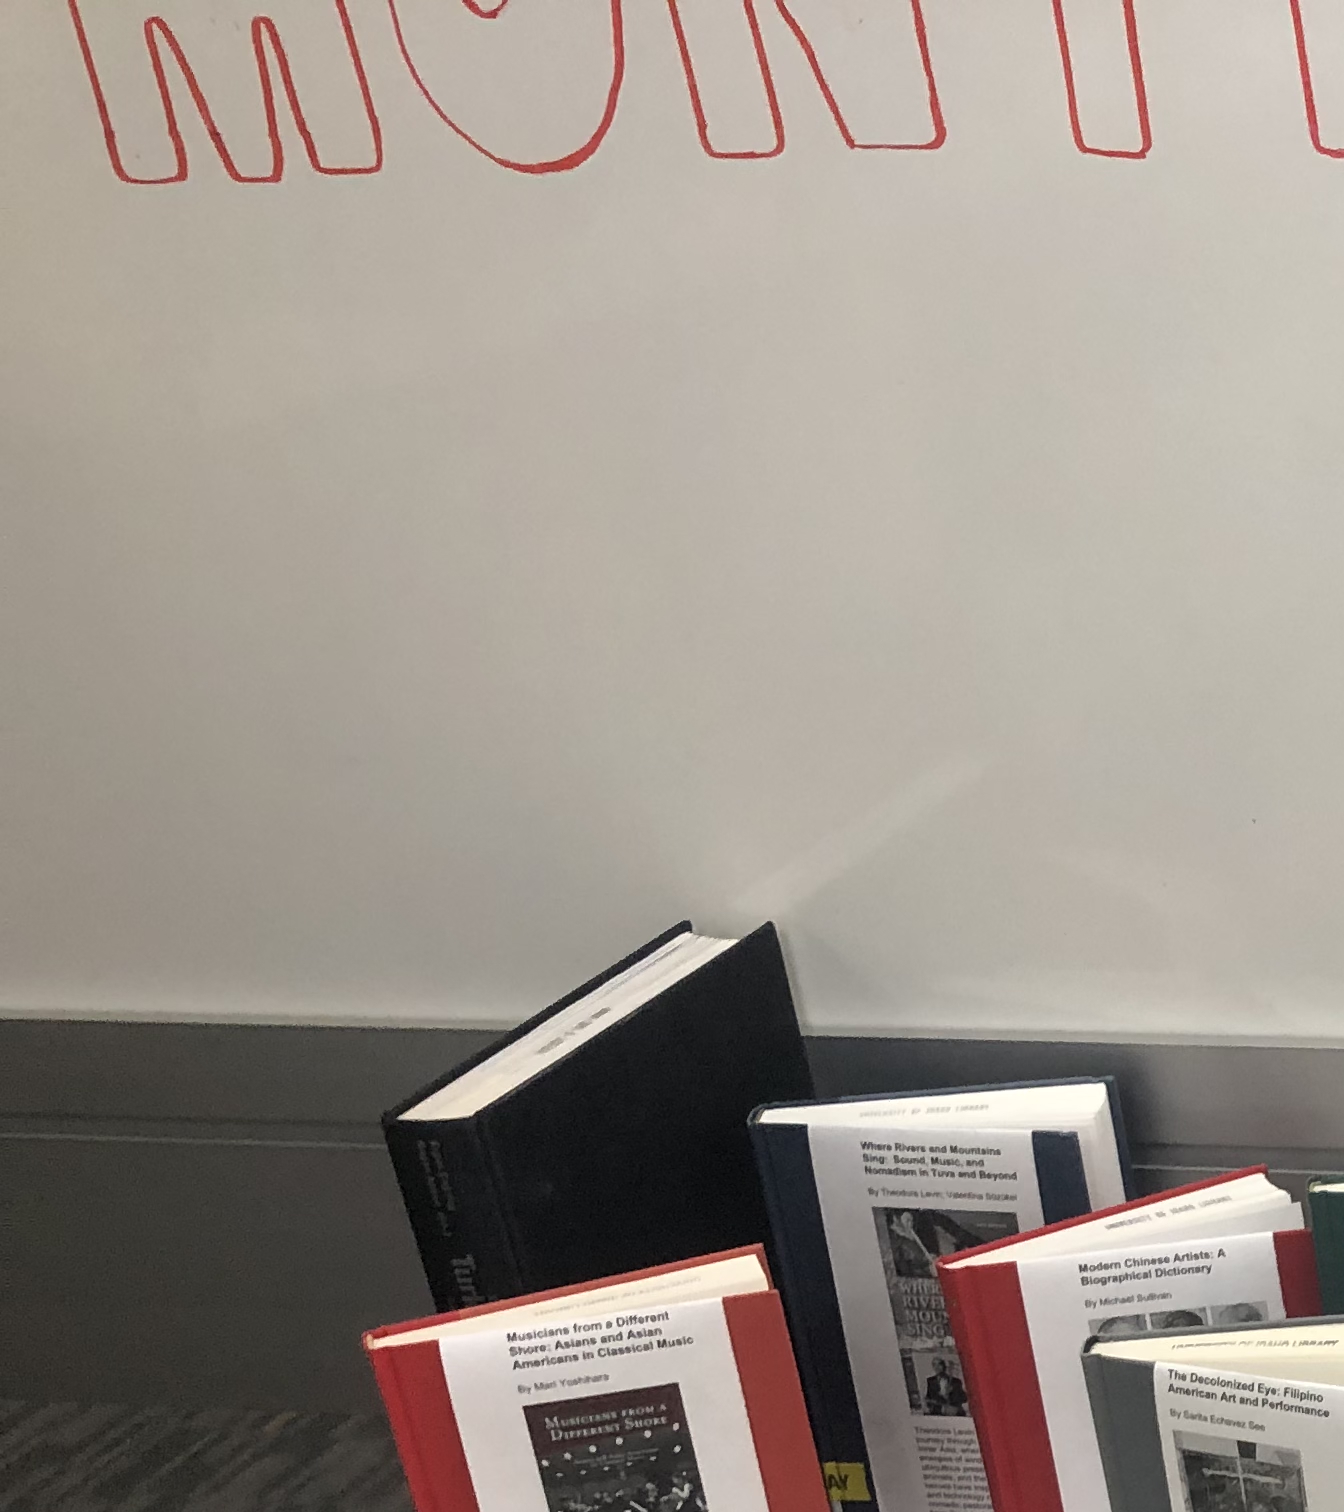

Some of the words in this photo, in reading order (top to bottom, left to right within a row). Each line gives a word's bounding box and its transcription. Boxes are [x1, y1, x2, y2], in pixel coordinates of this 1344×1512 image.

[860, 1141, 892, 1151] Where
[895, 1143, 926, 1152] Rivers
[929, 1144, 947, 1154] and
[950, 1144, 1002, 1156] Mountains
[893, 1154, 928, 1166] Sound,
[931, 1156, 963, 1167] Music,
[965, 1158, 985, 1167] and
[865, 1166, 917, 1177] Nomadism
[919, 1168, 929, 1177] in
[931, 1168, 956, 1178] Tuva
[958, 1170, 976, 1178] and
[979, 1170, 1018, 1181] Beyond
[1078, 1261, 1121, 1274] Modern
[1124, 1256, 1170, 1269] Chinese
[1173, 1251, 1214, 1264] Artists:
[1217, 1247, 1226, 1258] A
[1081, 1269, 1152, 1287] Biographical
[1155, 1264, 1213, 1278] Dictionary
[1085, 1299, 1097, 1310] By
[1100, 1295, 1134, 1307] Michael
[1137, 1291, 1173, 1303] Sullivan
[506, 1326, 570, 1343] Musicians
[572, 1321, 603, 1334] from
[605, 1320, 613, 1330] a
[615, 1311, 670, 1328] Different
[509, 1343, 552, 1357] Shore:
[554, 1337, 597, 1351] Asians
[600, 1331, 623, 1344] and
[627, 1327, 663, 1340] Asian
[513, 1353, 580, 1371] Americans
[582, 1350, 595, 1360] in
[597, 1342, 654, 1358] Classical
[657, 1336, 695, 1349] Music
[517, 1384, 532, 1395] By
[1167, 1368, 1187, 1382] The
[1190, 1372, 1255, 1393] Decolonized
[1257, 1383, 1281, 1397] Eye:
[1283, 1386, 1324, 1403] Filipino
[1167, 1383, 1218, 1401] American
[1220, 1391, 1237, 1404] Art
[1239, 1395, 1259, 1408] and
[1261, 1397, 1330, 1418] Performance
[1170, 1408, 1182, 1420] By
[1183, 1410, 1209, 1423] Sarita
[1210, 1414, 1247, 1430] Echavez
[1248, 1420, 1266, 1432] See
